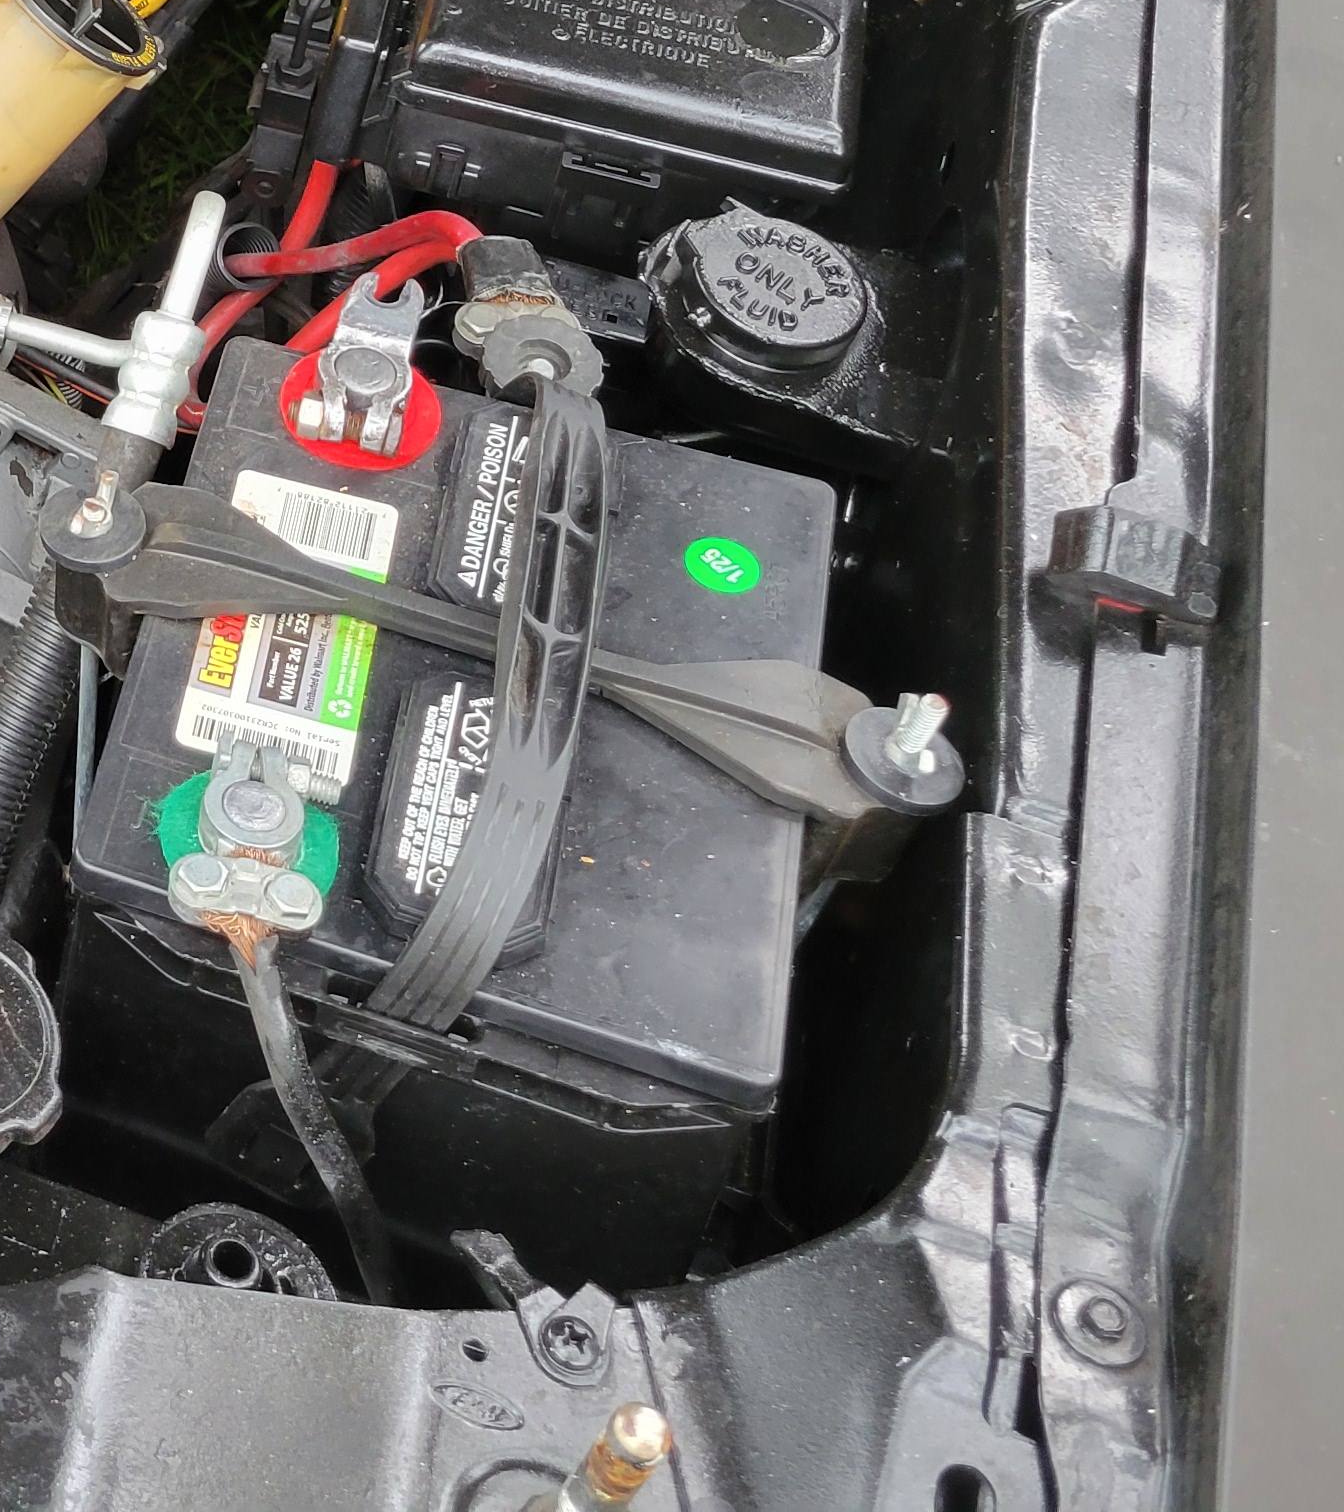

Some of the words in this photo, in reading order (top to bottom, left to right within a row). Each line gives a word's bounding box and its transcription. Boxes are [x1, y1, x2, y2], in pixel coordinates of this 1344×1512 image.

[737, 227, 851, 298] WASHER
[735, 251, 826, 312] ONLY
[716, 275, 799, 332] FLUID
[460, 498, 493, 571] DANGER
[478, 422, 509, 486] POISON
[698, 547, 745, 584] 1/25
[287, 646, 303, 663] 26
[278, 660, 300, 701] VALUE
[440, 694, 454, 717] LEVEL
[285, 725, 301, 737] No:
[421, 705, 440, 745] CHILDREN
[436, 717, 448, 737] AND
[306, 731, 341, 747] Serial
[430, 736, 444, 761] TIGHT
[418, 743, 431, 759] OF
[425, 762, 440, 785] CAPS
[406, 804, 419, 820] OF
[453, 797, 469, 814] GET
[403, 818, 416, 838] OUT
[417, 807, 430, 830] KEEP
[398, 837, 412, 860] KEEP
[409, 847, 422, 866] NOT
[428, 837, 446, 864] FLUSH
[406, 866, 419, 881] DO
